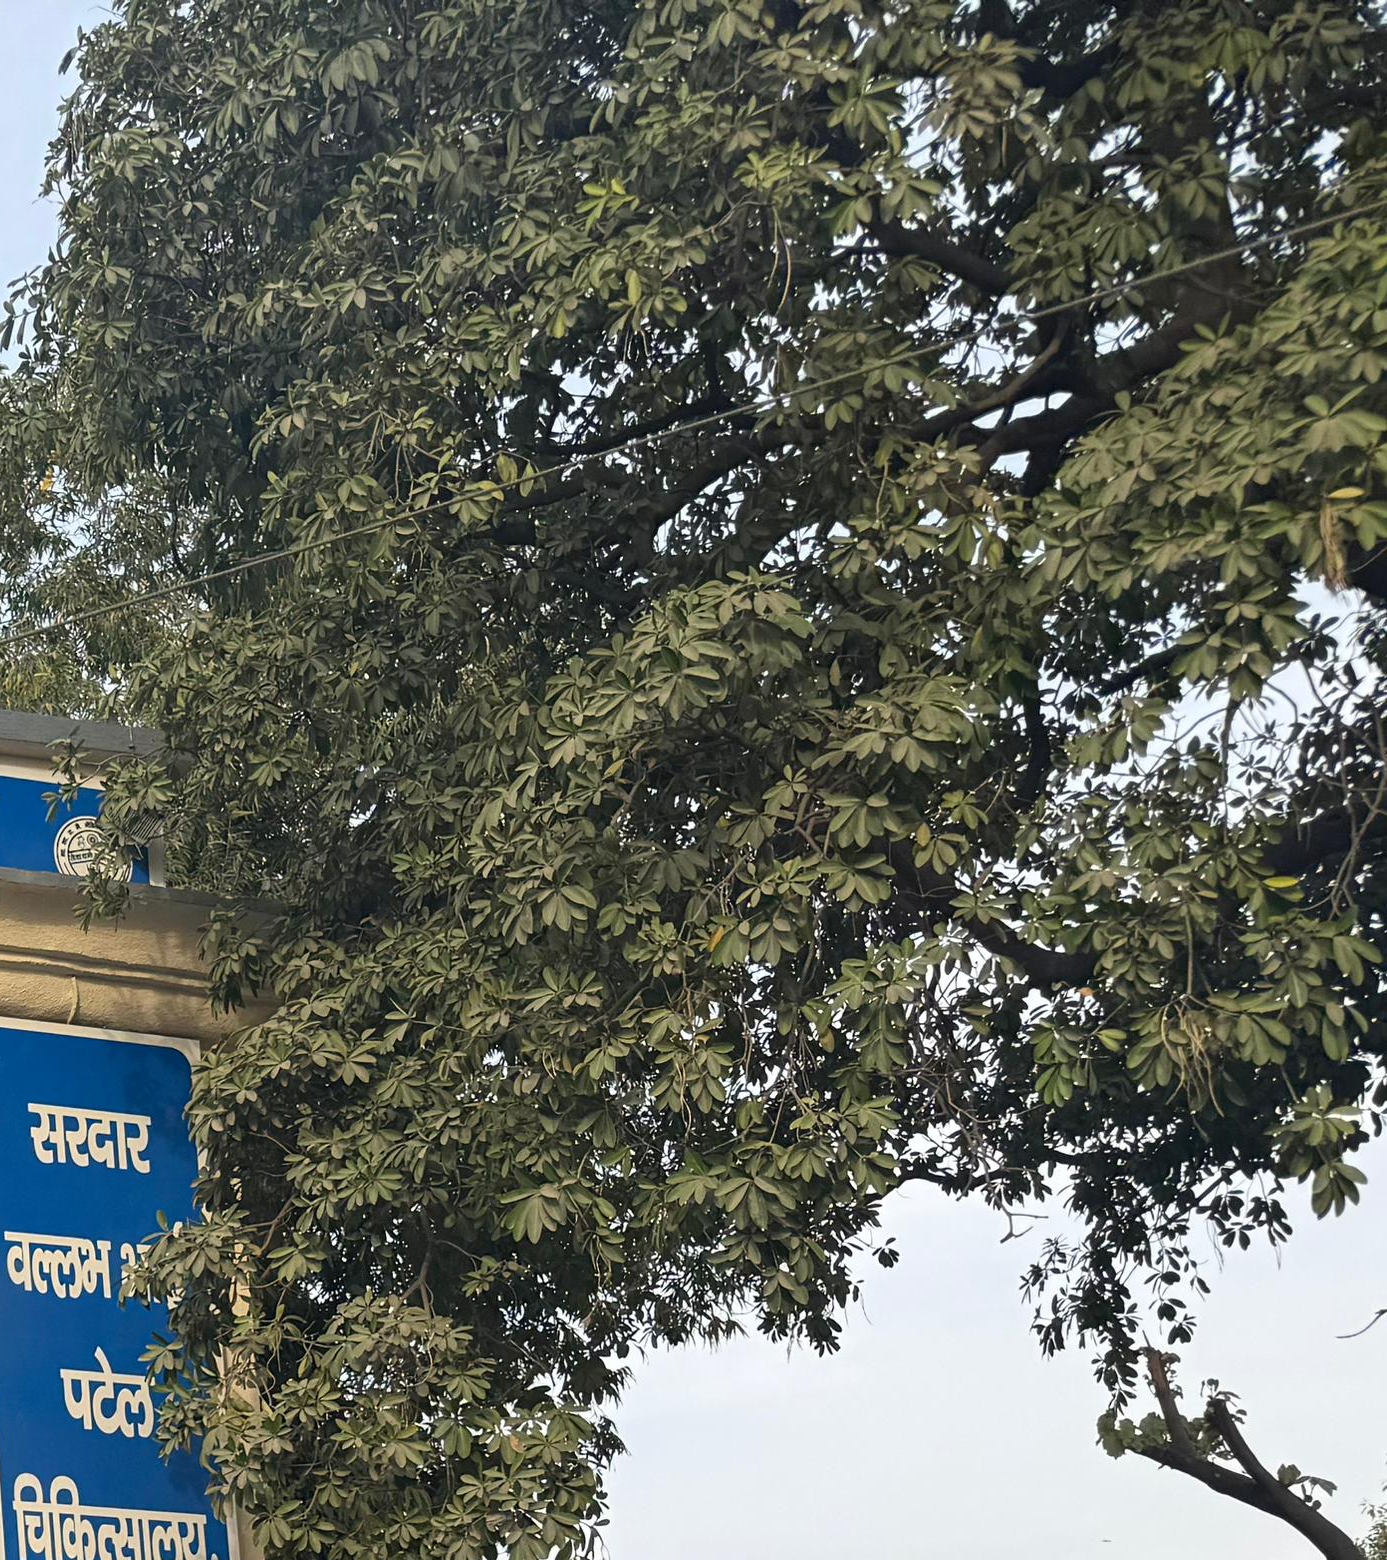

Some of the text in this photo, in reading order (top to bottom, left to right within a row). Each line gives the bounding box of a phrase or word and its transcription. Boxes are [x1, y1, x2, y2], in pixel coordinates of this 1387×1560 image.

[28, 1103, 151, 1173] सरदार
[4, 1231, 112, 1299] वल्लभ
[60, 1347, 154, 1438] पटेल
